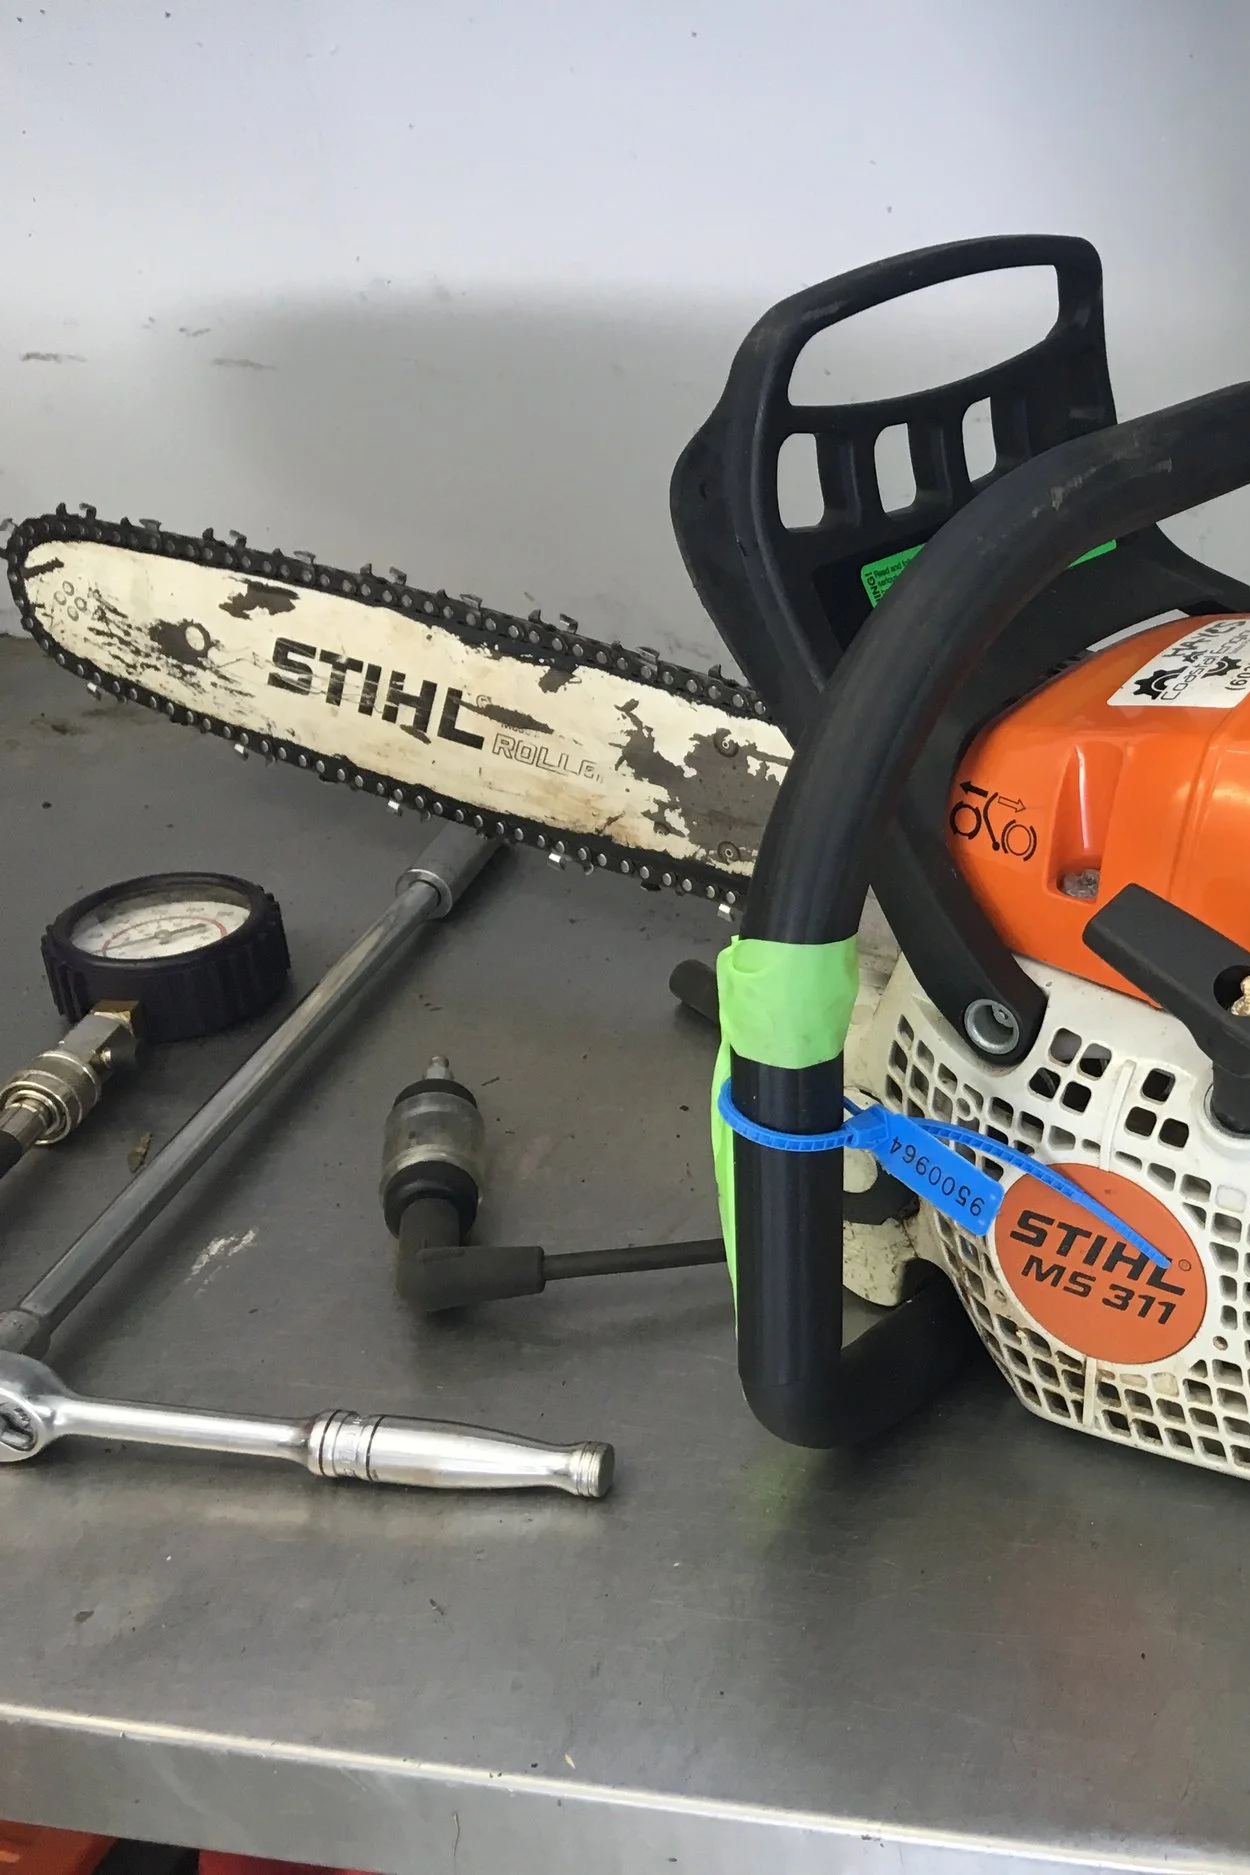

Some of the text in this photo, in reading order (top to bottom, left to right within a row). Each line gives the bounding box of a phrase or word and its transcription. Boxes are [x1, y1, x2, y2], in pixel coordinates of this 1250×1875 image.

[266, 636, 485, 751] STIHL
[1160, 655, 1220, 700] Coastal
[891, 1135, 986, 1217] 9500964
[1009, 1209, 1186, 1296] STIHL
[1021, 1255, 1177, 1325] MS 311
